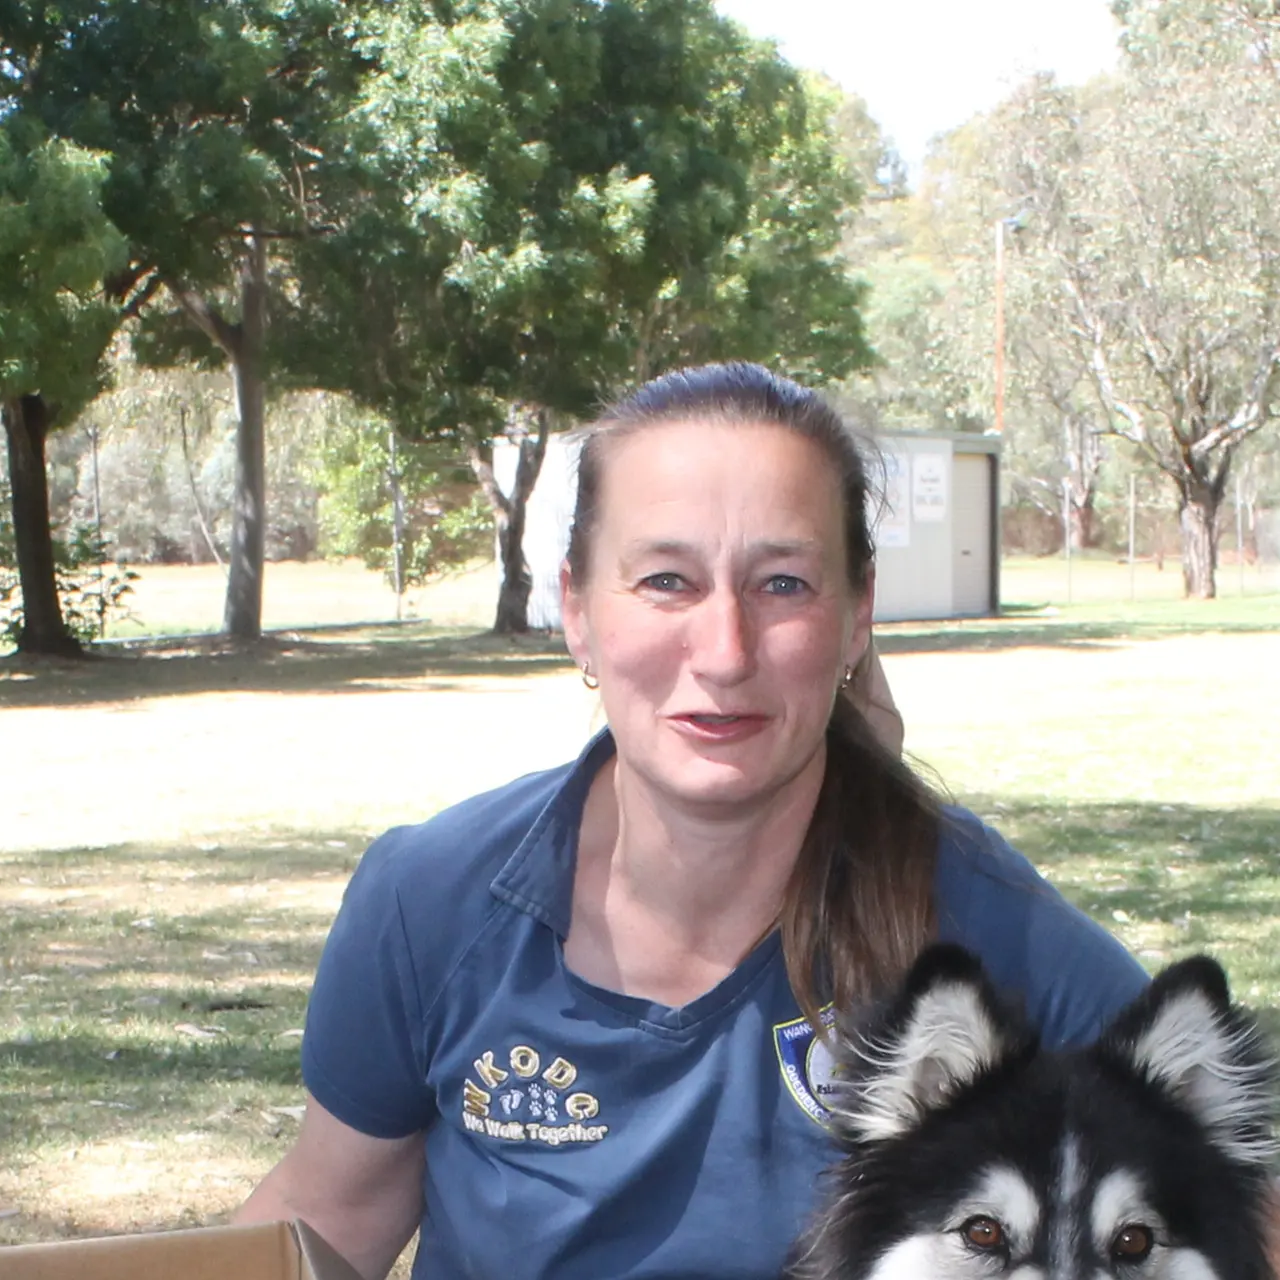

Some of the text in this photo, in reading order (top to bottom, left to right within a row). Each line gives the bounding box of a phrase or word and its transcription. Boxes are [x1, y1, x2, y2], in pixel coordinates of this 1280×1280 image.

[463, 1045, 599, 1120] WKODC
[462, 1111, 608, 1146] We Walk Together
